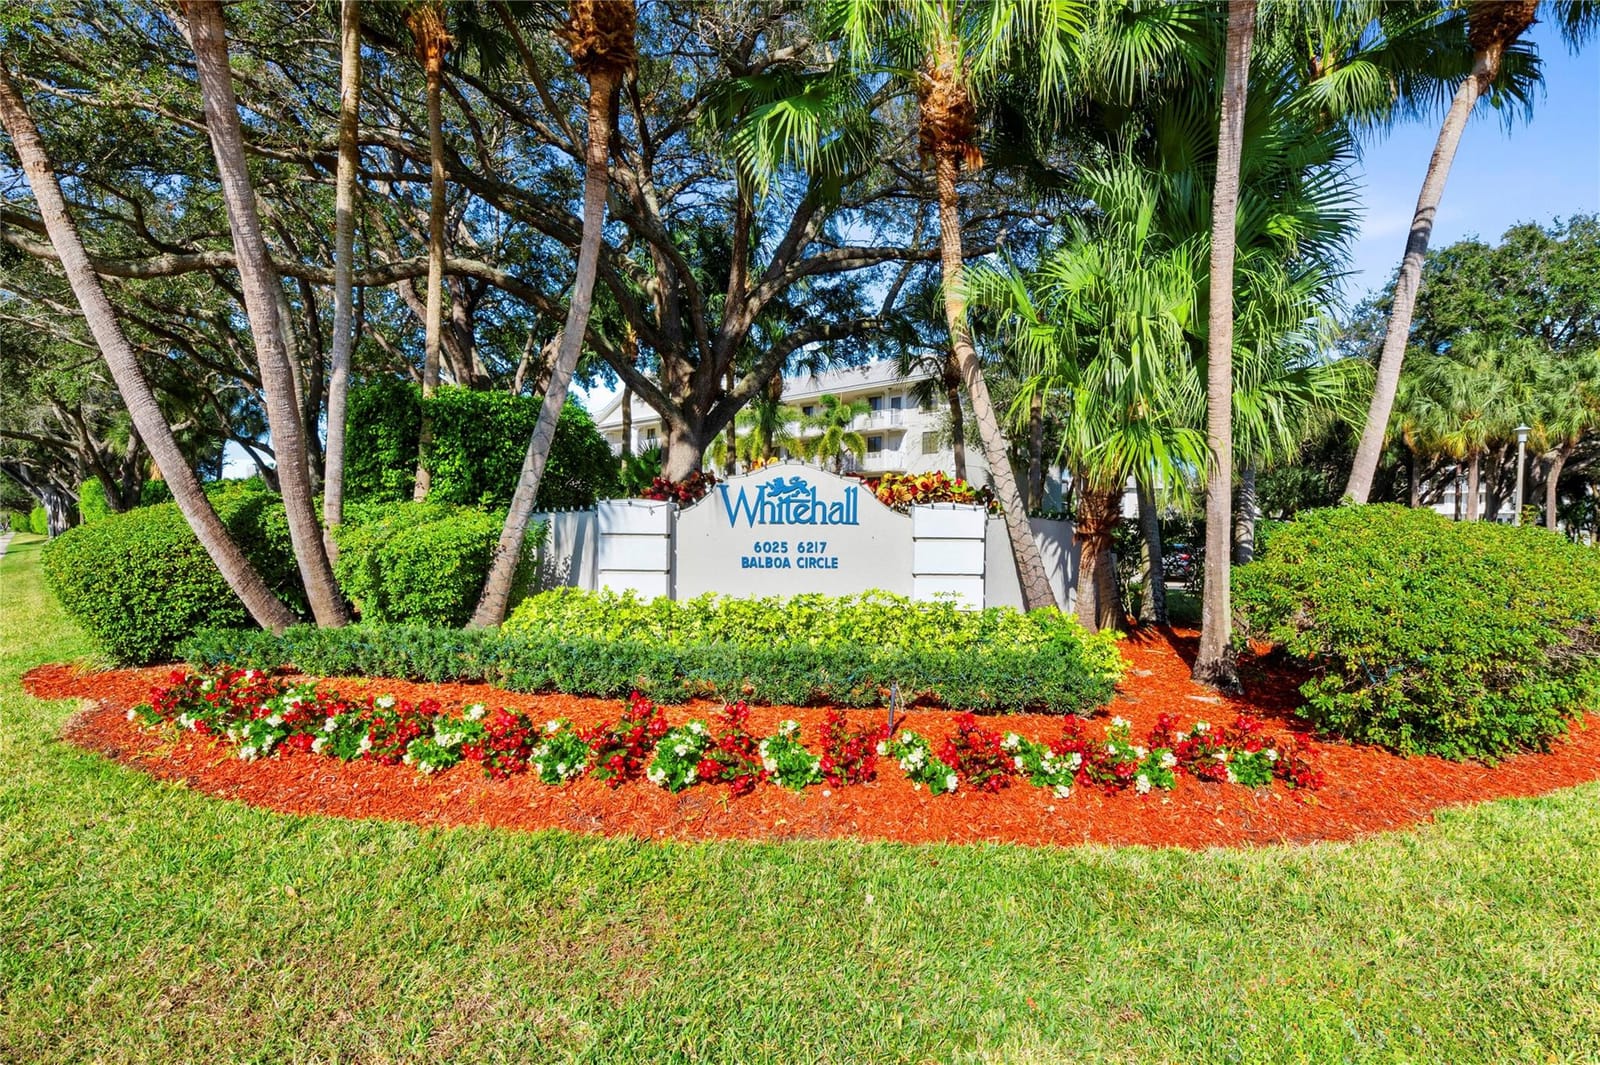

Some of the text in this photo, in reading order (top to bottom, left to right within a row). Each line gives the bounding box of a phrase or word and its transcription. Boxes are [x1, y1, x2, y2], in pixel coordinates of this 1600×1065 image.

[716, 484, 860, 528] Whitehall
[753, 541, 827, 554] 6025 6217
[741, 556, 839, 569] BALBOA CIRCLE
